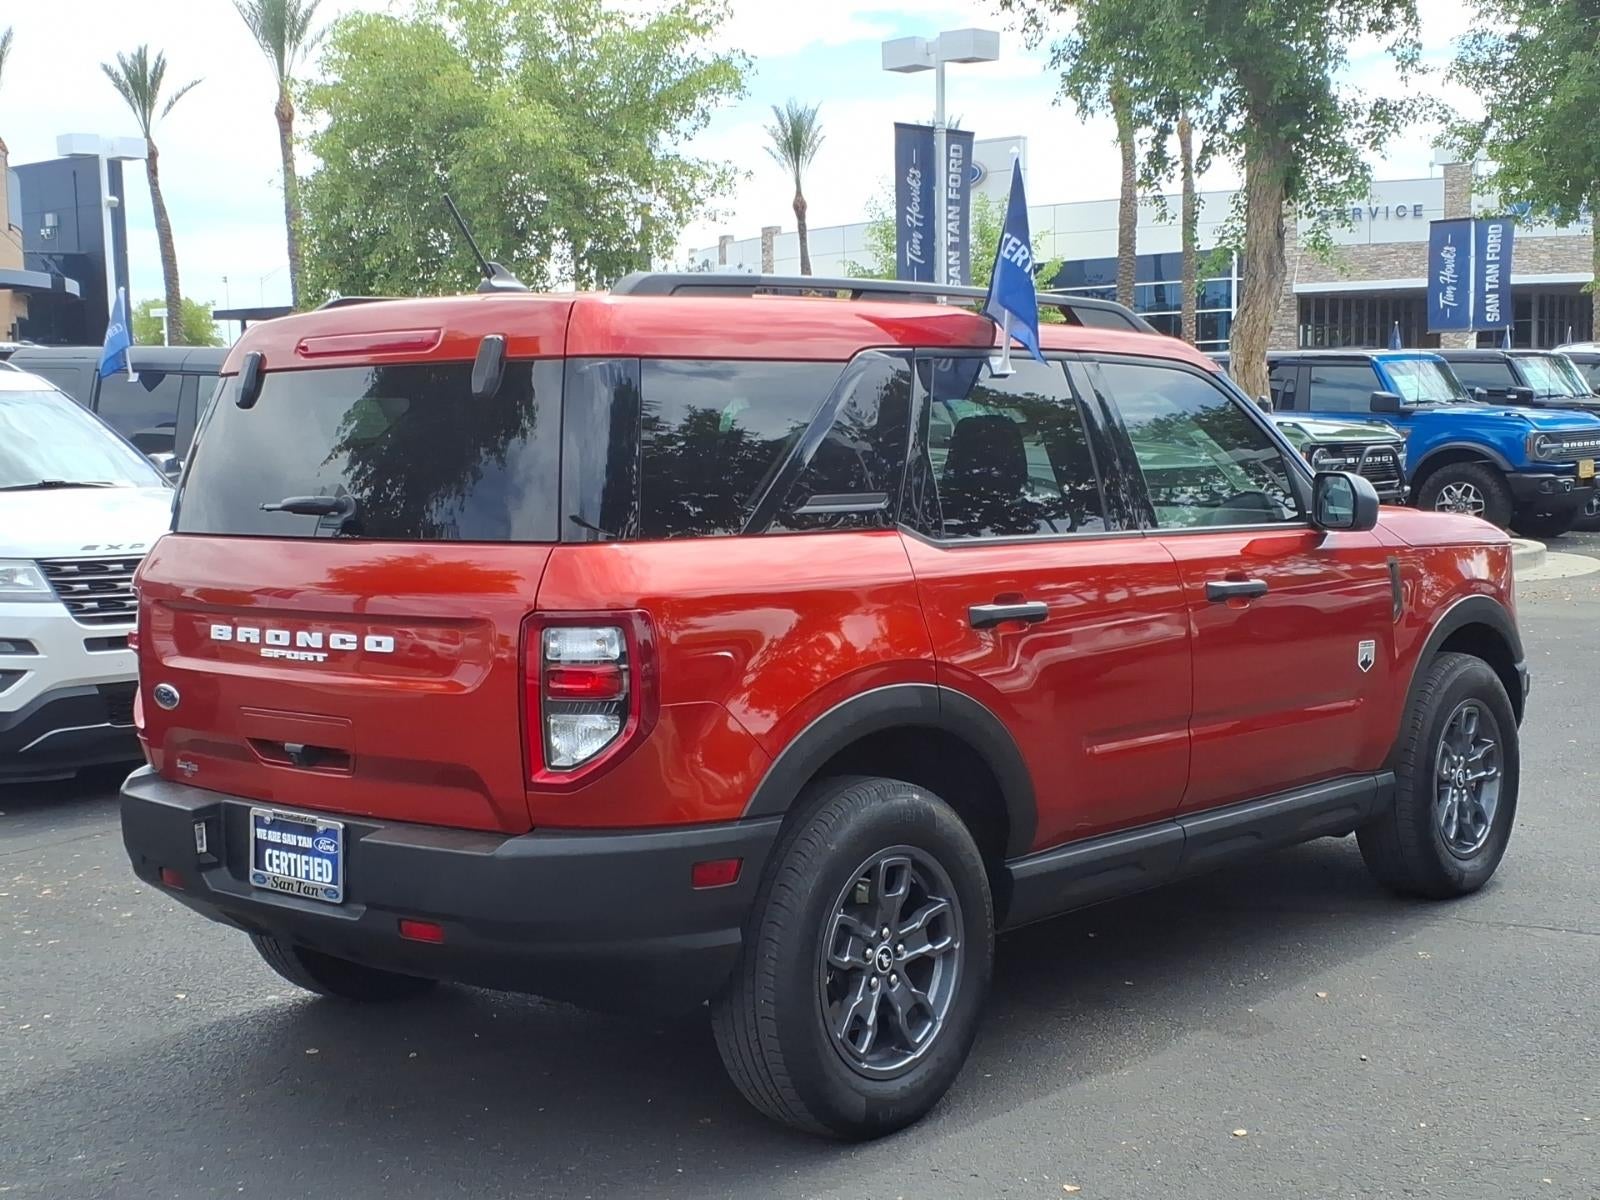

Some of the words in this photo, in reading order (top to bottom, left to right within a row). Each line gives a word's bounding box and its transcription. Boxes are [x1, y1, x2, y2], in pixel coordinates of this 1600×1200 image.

[947, 143, 963, 200] FORD
[905, 167, 924, 228] Hovik's
[947, 205, 960, 246] TAN
[1317, 204, 1424, 221] SRVICE
[905, 231, 925, 267] Tim
[1486, 223, 1503, 261] FORD
[1485, 264, 1500, 291] TAN
[1439, 285, 1458, 309] Tim
[1485, 293, 1500, 322] SAN
[210, 624, 394, 652] BRONCO
[260, 647, 328, 662] SPORT
[256, 828, 267, 840] WE
[267, 830, 282, 843] ARE
[282, 832, 297, 846] SAN
[297, 835, 313, 848] TAN
[264, 848, 333, 883] CERTIFIED
[271, 875, 294, 892] San
[295, 880, 320, 897] Tan
